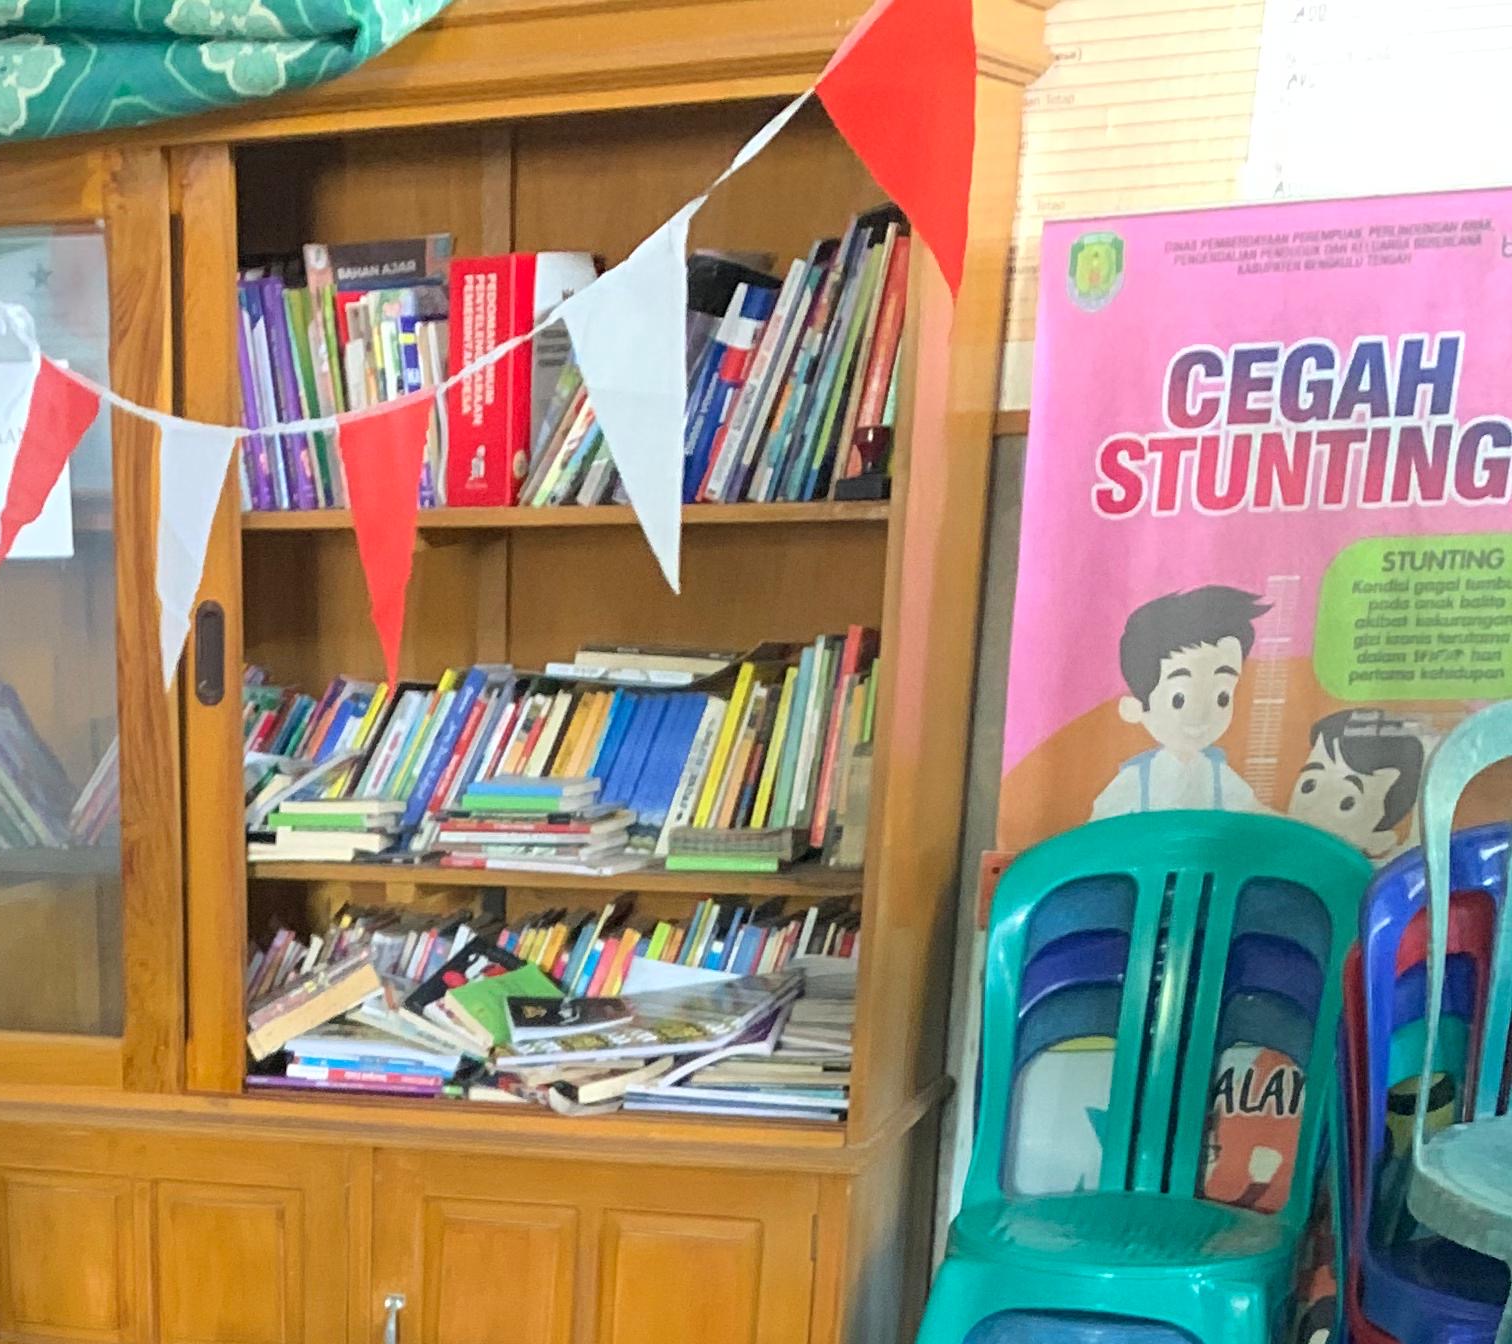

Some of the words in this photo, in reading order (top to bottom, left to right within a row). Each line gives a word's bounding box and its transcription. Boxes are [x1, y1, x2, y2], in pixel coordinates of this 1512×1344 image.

[1165, 332, 1464, 430] CEGAH
[1094, 418, 1512, 518] STUNTING
[1381, 548, 1505, 572] STUNTING
